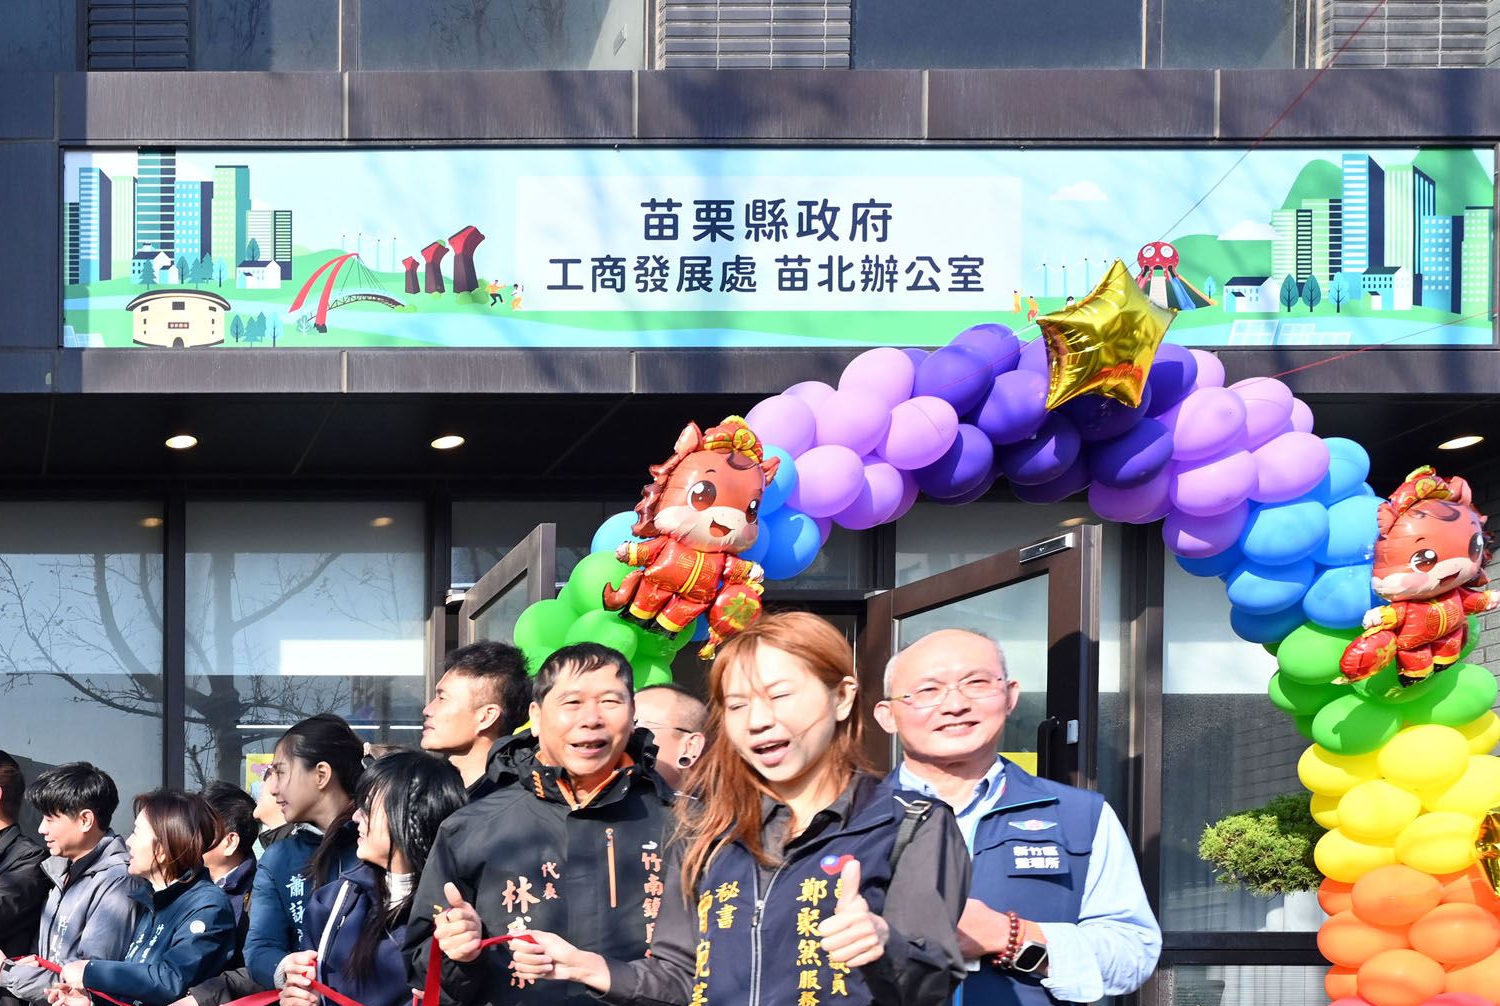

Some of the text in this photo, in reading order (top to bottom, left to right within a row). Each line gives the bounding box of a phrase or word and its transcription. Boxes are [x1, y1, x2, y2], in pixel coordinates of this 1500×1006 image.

[640, 197, 894, 242] 苗栗縣政府
[546, 254, 986, 294] 工商發展處 苗北辦公室
[286, 873, 307, 942] 蕭詠
[715, 881, 740, 929] 秘書
